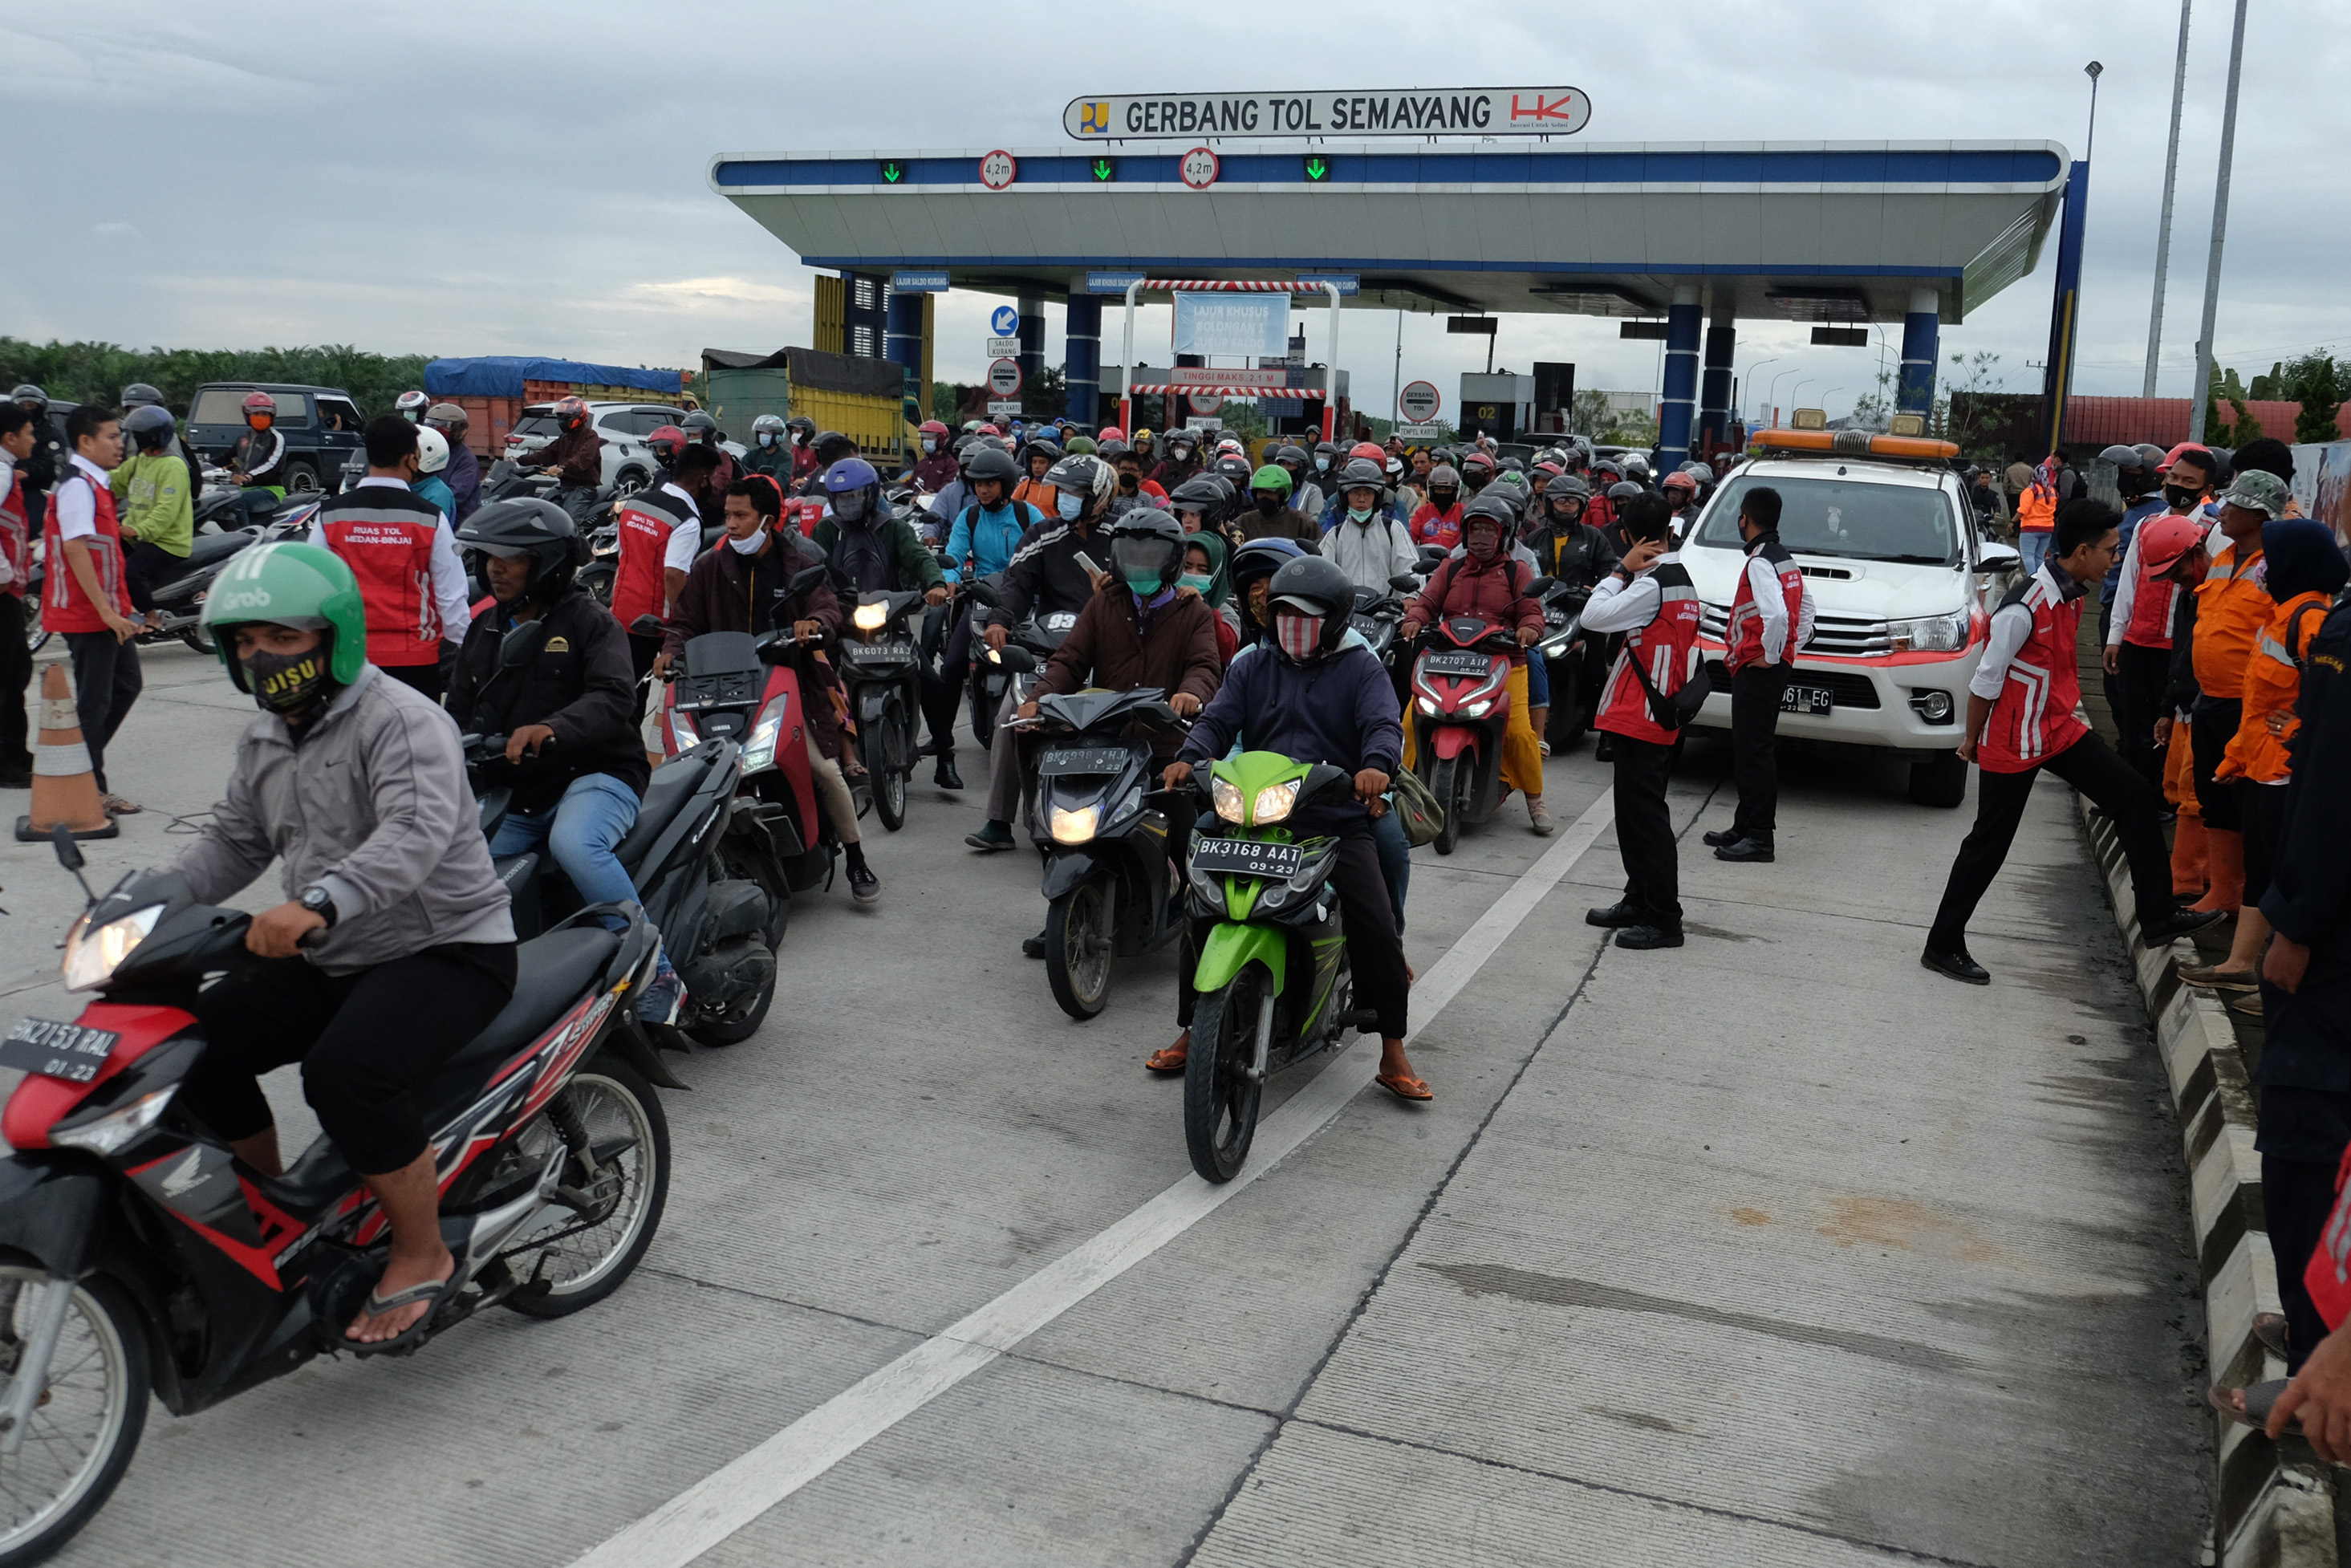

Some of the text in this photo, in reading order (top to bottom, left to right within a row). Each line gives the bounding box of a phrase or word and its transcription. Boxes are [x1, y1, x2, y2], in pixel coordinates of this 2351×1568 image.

[1127, 95, 1491, 133] GERBANG TOL SEMAYANG
[895, 278, 947, 286] LAJUR SALDO KURANG
[1089, 278, 1102, 286] LAJUR
[1102, 278, 1118, 286] KHUSUS
[1118, 278, 1131, 286] SALDO
[1194, 306, 1269, 317] LAJUR KHUSUS
[1196, 322, 1255, 333] GOLONGAN
[1184, 372, 1214, 380] TINGGI
[1217, 372, 1247, 381] MAKS.
[1249, 374, 1261, 383] 2,1
[1478, 406, 1496, 419] 02
[1188, 420, 1221, 429] TEMPEL KARTU
[353, 526, 402, 535] RUAS TOL
[344, 535, 412, 545] MEDAN-BINJAI
[1047, 613, 1077, 630] 93
[852, 647, 911, 656] BK6073 RAJ
[1430, 656, 1465, 665] BK2707
[1812, 690, 1829, 707] EG
[1200, 841, 1300, 862] BK3168 AAT
[6, 1018, 116, 1058] BK2153 RAL
